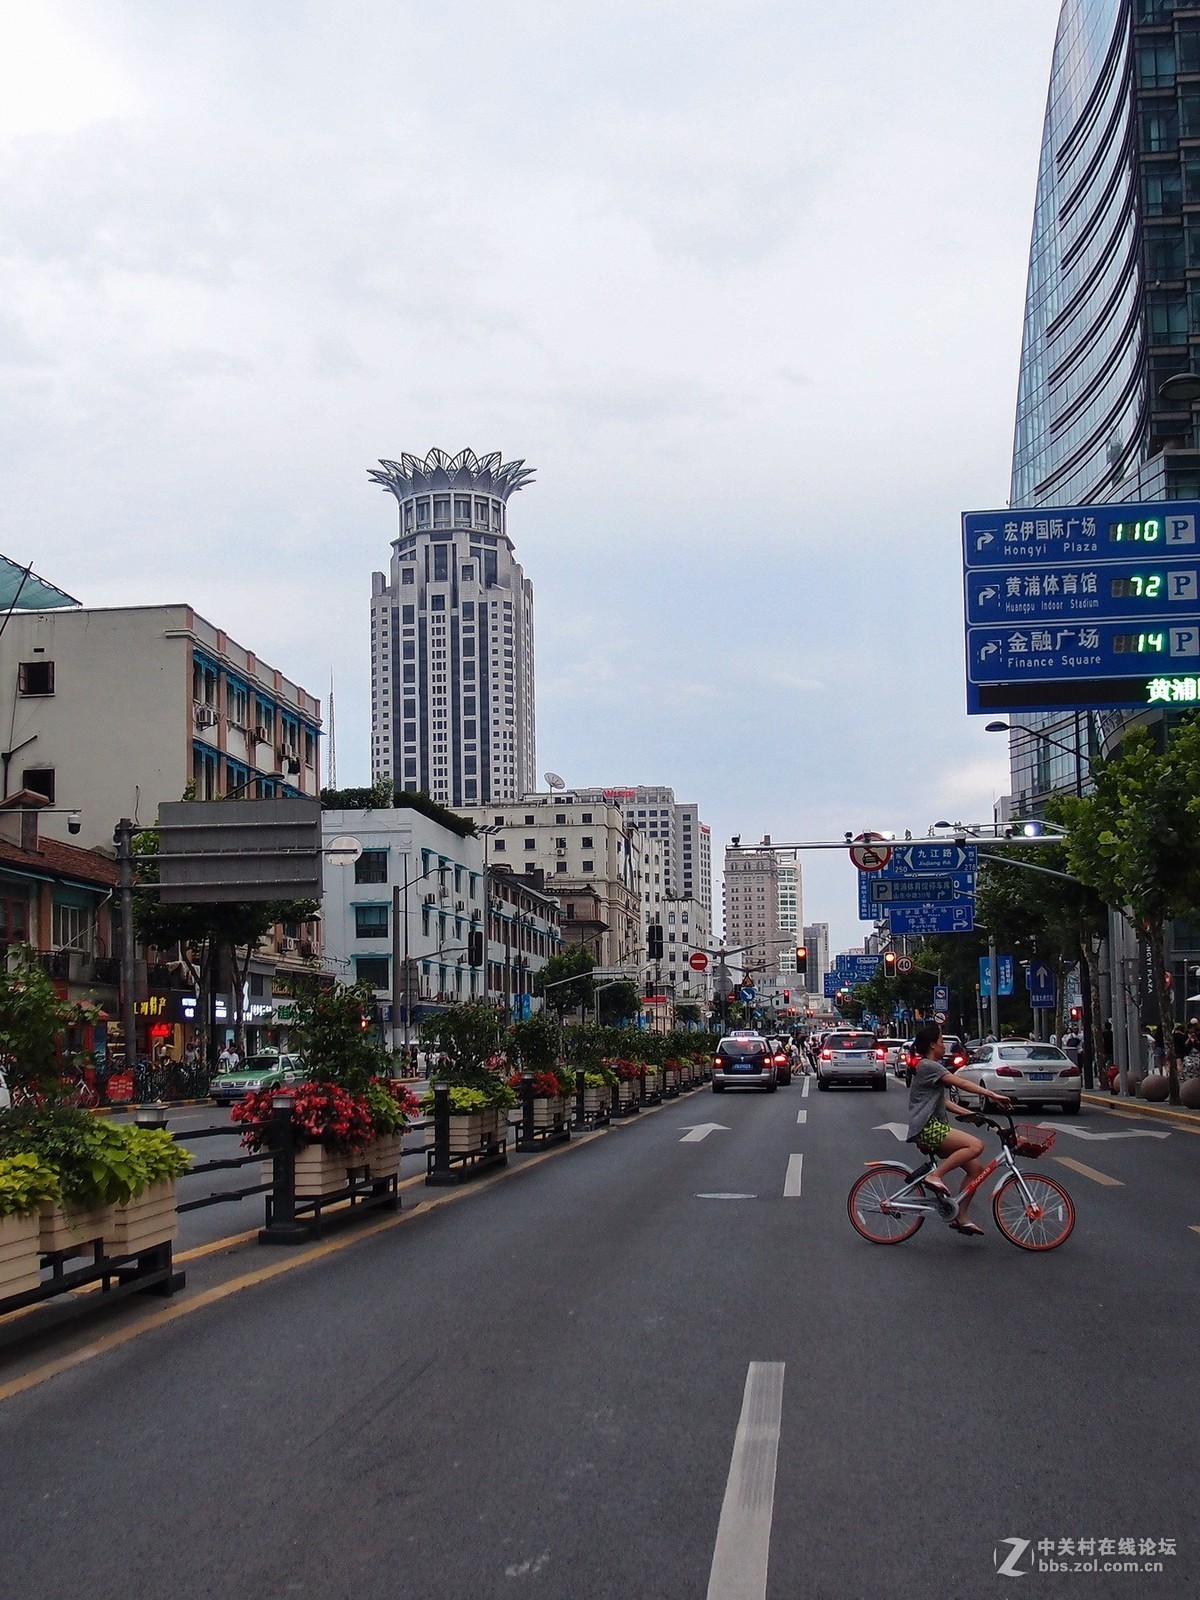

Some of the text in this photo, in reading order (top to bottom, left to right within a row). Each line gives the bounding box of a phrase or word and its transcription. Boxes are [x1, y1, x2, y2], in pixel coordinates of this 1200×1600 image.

[1004, 517, 1097, 542] 宏伊国际广场
[1115, 520, 1159, 542] 110
[1172, 520, 1189, 540] P
[1004, 542, 1098, 557] Hongyi Plaza
[1006, 572, 1098, 597] 黄浦体育馆
[1131, 576, 1161, 597] 72
[1174, 575, 1191, 595] P
[1006, 599, 1099, 614] Huangpu Indoor Stadium
[1007, 629, 1099, 653] 金融广场
[1138, 634, 1163, 652] 14
[1176, 632, 1193, 652] P
[1008, 655, 1101, 668] Finance Square
[1145, 677, 1200, 703] 黄浦
[918, 849, 952, 858] 九江路
[877, 884, 888, 899] P
[956, 910, 964, 918] P
[899, 961, 910, 969] 40
